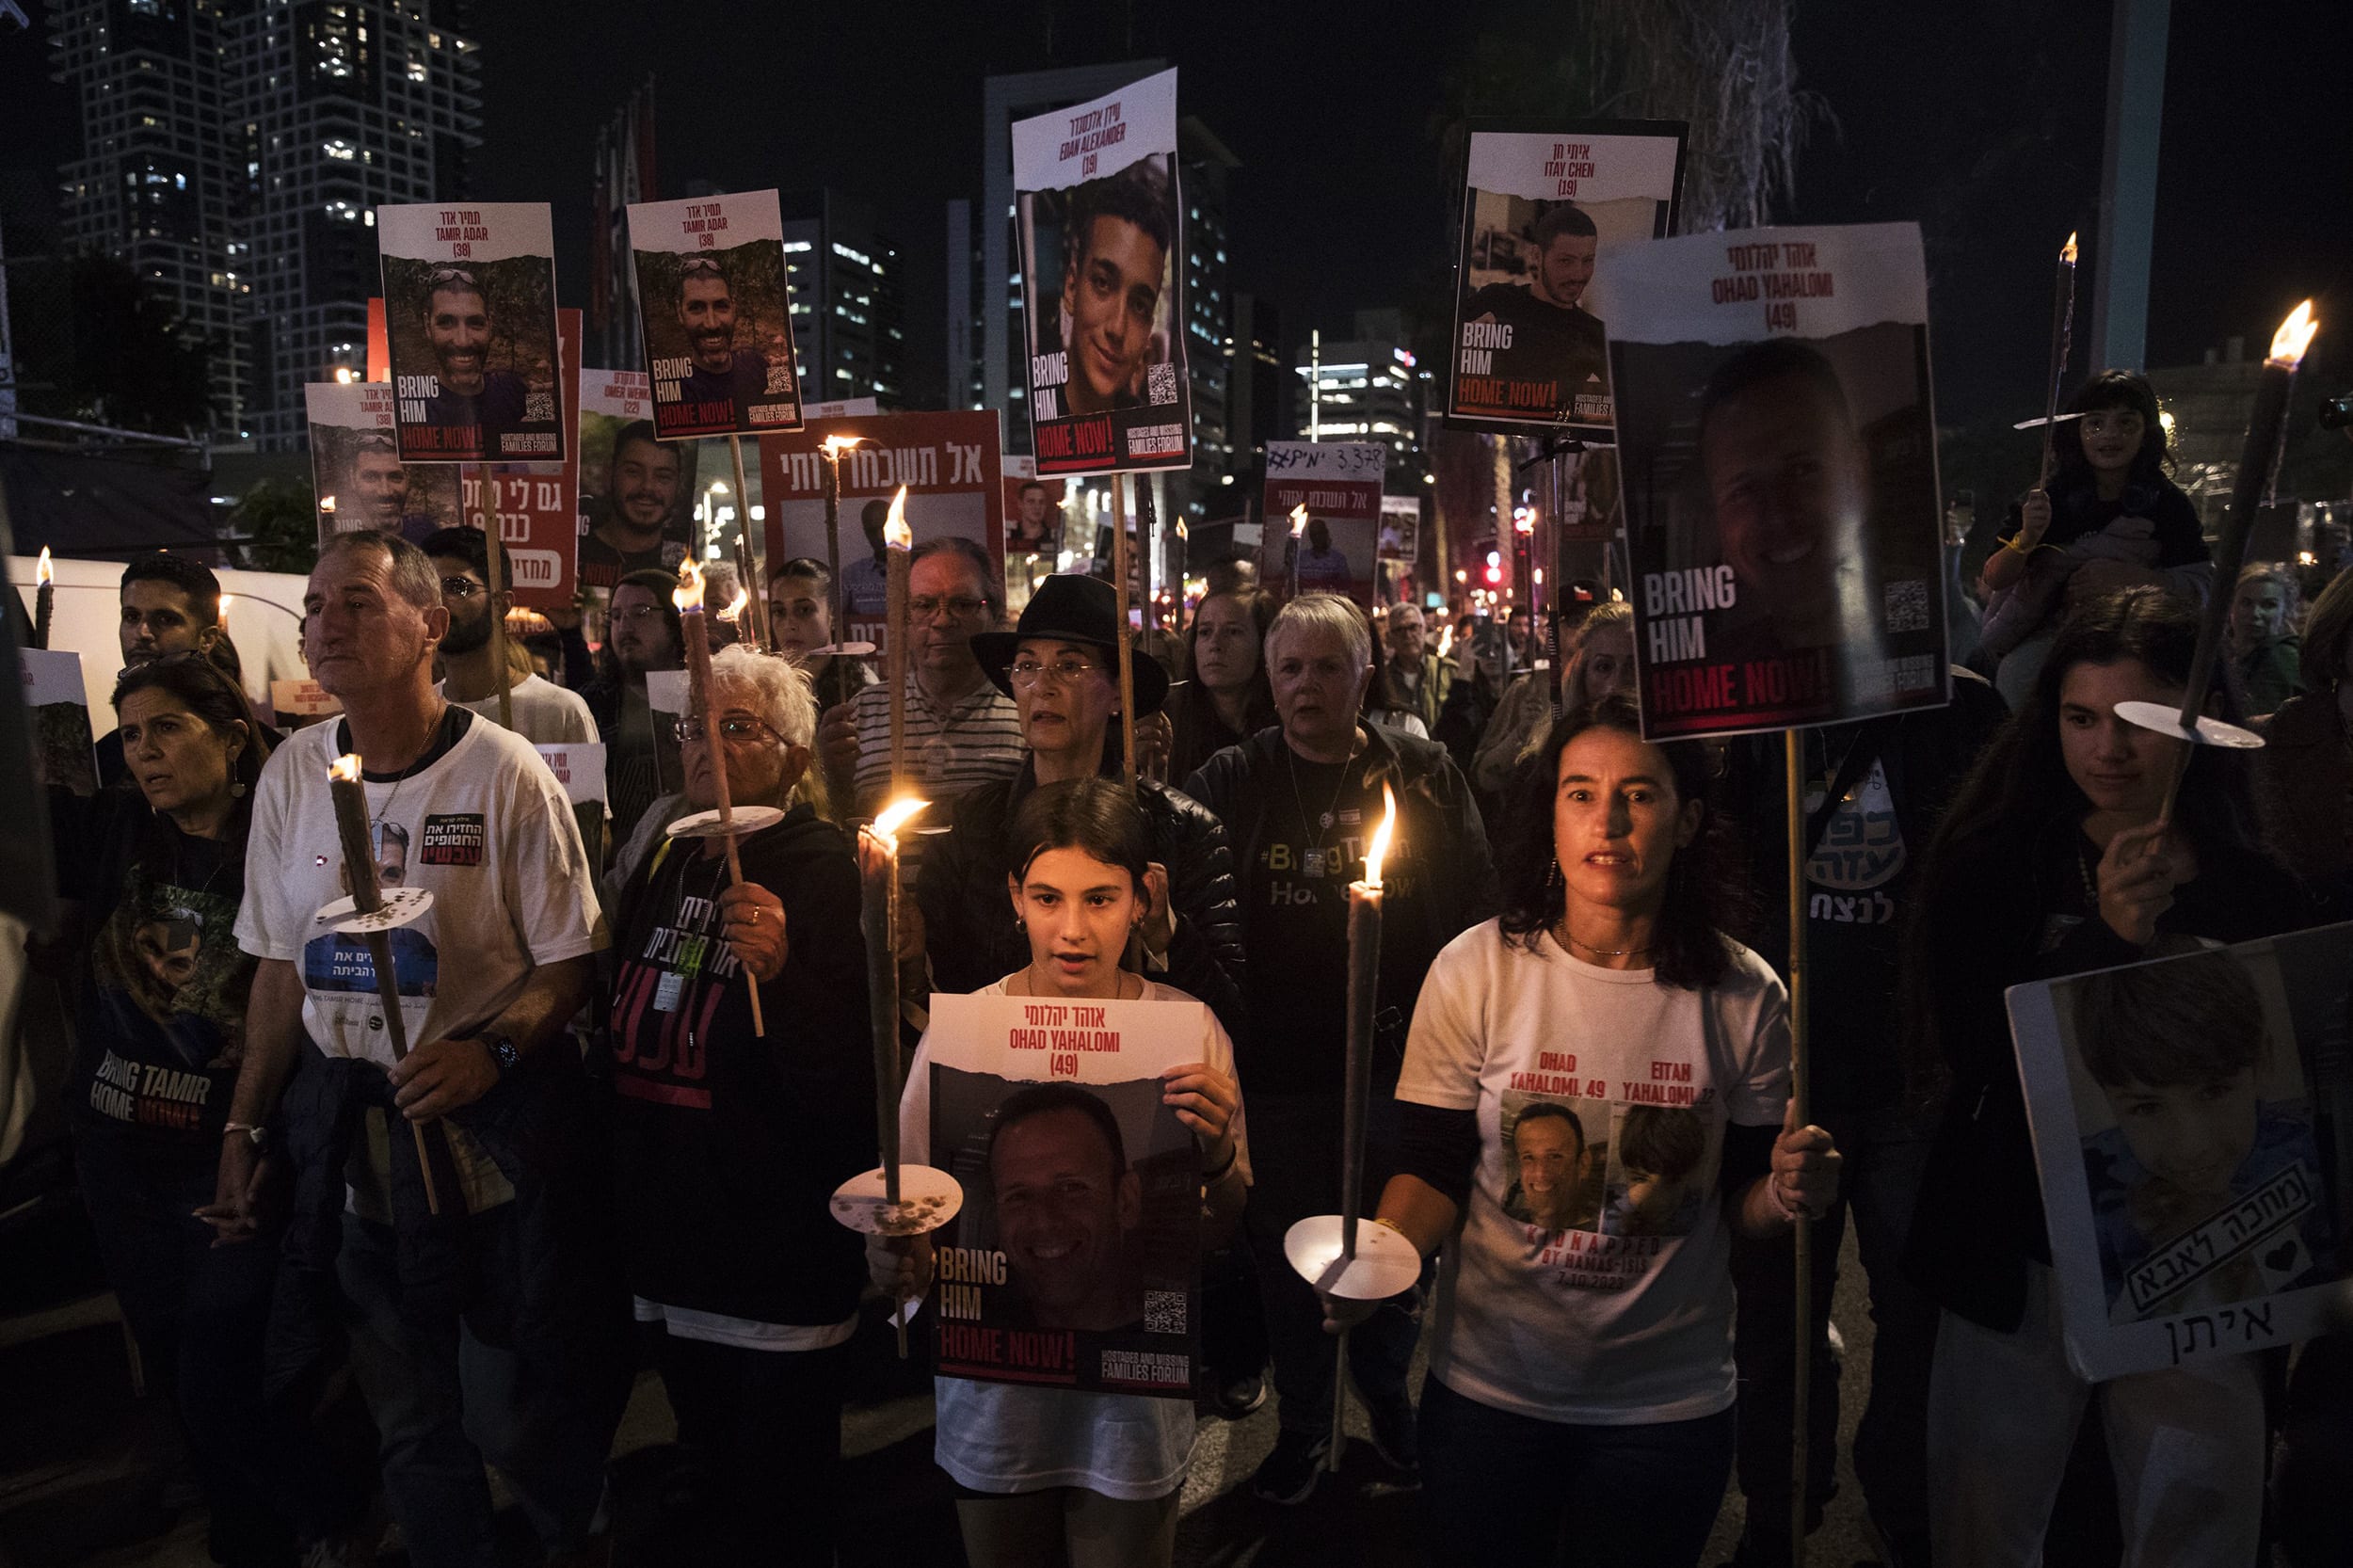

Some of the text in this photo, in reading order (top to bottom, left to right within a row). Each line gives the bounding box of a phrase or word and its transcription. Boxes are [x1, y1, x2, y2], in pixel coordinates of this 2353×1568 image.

[1059, 122, 1127, 162] EDAN ALEXANDER
[1553, 143, 1591, 161] איתי חן
[1082, 152, 1097, 177] (19)
[1545, 161, 1594, 178] ITAY CHEN
[1558, 179, 1577, 198] (19)
[440, 212, 481, 225] תמיר אדר
[686, 203, 722, 219] תמיר אדר
[436, 227, 488, 241] TAMIR ADAR
[682, 216, 728, 233] TAMIR ADAR
[453, 243, 471, 258] (38)
[698, 232, 714, 248] (38)
[1727, 243, 1817, 271] אוהד יהלומי
[1711, 273, 1834, 305] OHAD YAHALOMI
[1766, 301, 1797, 331] (49)
[1462, 322, 1513, 350] BRING
[652, 357, 694, 381] BRING
[1032, 350, 1069, 388] BRING
[1460, 349, 1493, 376] HIM
[397, 376, 440, 399] BRING
[655, 380, 682, 403] HIM
[1458, 378, 1558, 408] HOME NOW!
[360, 402, 383, 412] TAMIR
[400, 400, 427, 423] HIM
[659, 397, 736, 427] HOME NOW!
[749, 410, 796, 422] FAMILIES FORUM
[1033, 388, 1058, 423] HIM
[1574, 403, 1609, 416] FAMILIES
[376, 413, 392, 426] (38)
[401, 423, 484, 450] HOME NOW!
[501, 440, 558, 453] FAMILIES FORUM
[1036, 415, 1114, 458] HOME NOW!
[1128, 435, 1184, 456] FAMILIES FORUM
[780, 441, 984, 491] אל תשכחו ותי
[509, 478, 530, 511] לי
[536, 482, 562, 512] גם
[1278, 489, 1305, 507] אותי
[1308, 489, 1347, 509] תשכחו
[1352, 490, 1368, 509] אל
[496, 513, 530, 543] כבר
[1644, 565, 1737, 616] BRING
[1648, 616, 1706, 664] HIM
[1651, 664, 1737, 714] HOME
[1745, 648, 1832, 706] NOW!
[424, 834, 482, 847] החטופים
[426, 824, 482, 835] החזירו את
[422, 847, 482, 863] עכשיו
[1809, 890, 1895, 924] לנצח
[334, 952, 353, 962] את
[332, 966, 370, 977] הביתה
[1025, 1004, 1105, 1028] אוהד יהלומי
[1010, 1029, 1120, 1052] OHAD YAHALOMI
[1050, 1052, 1079, 1078] (49)
[1539, 1051, 1577, 1073] OHAD
[1651, 1061, 1692, 1082] EITAN
[96, 1048, 212, 1106] BRING TAMIR
[1586, 1080, 1606, 1099] 49
[90, 1080, 136, 1123] HOME
[2137, 1177, 2302, 1299] מחכה לאבא
[940, 1245, 1008, 1287] BRING
[1542, 1249, 1647, 1273] BY HAMAS-ISIS
[1557, 1271, 1625, 1290] 7.10.2023
[940, 1283, 983, 1321] HIM
[2165, 1302, 2274, 1365] איתן
[939, 1323, 1076, 1371] HOME NOW!
[1101, 1349, 1190, 1368] HOSTAGES AND MISSING
[1101, 1362, 1190, 1384] FAMILIES FORUM
